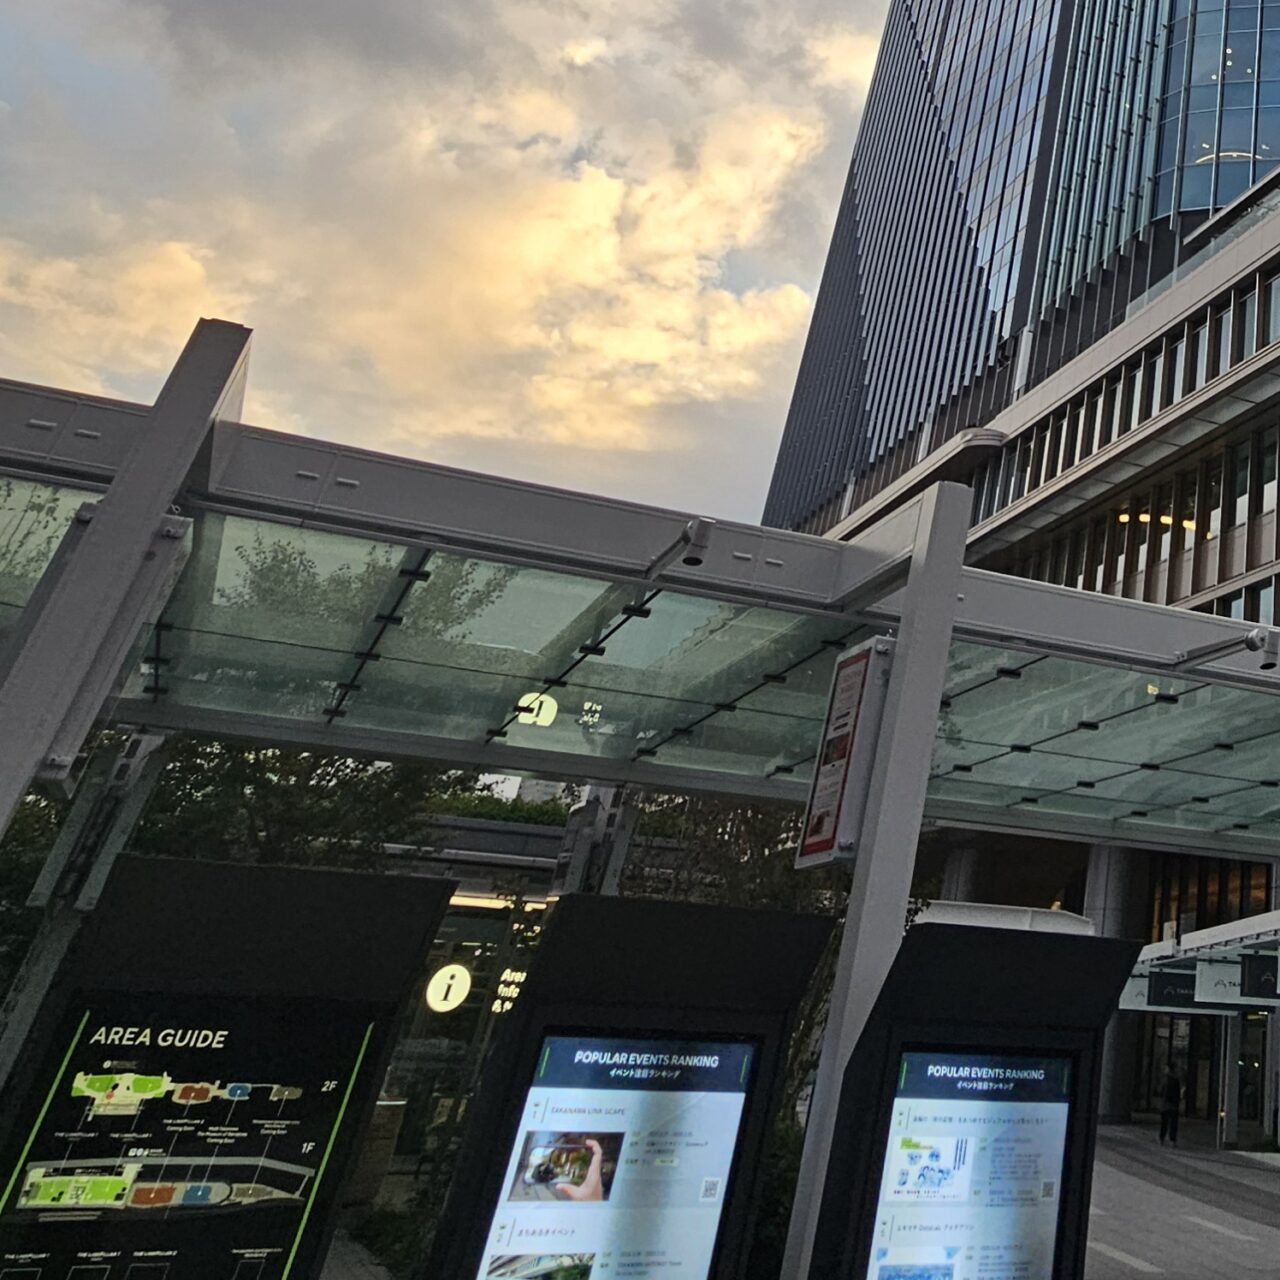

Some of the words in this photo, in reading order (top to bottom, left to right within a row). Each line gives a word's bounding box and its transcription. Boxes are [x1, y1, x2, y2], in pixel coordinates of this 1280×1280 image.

[89, 1026, 152, 1046] AREA
[157, 1028, 229, 1049] GUIDE
[574, 1050, 626, 1065] POPULAR
[628, 1052, 670, 1066] EVENTS
[671, 1054, 719, 1068] RANKING
[927, 1064, 970, 1078] POPULAR
[971, 1067, 1004, 1079] EVENTS
[1005, 1069, 1045, 1080] RANKING
[321, 1080, 338, 1092] 2F
[301, 1142, 316, 1154] 1F
